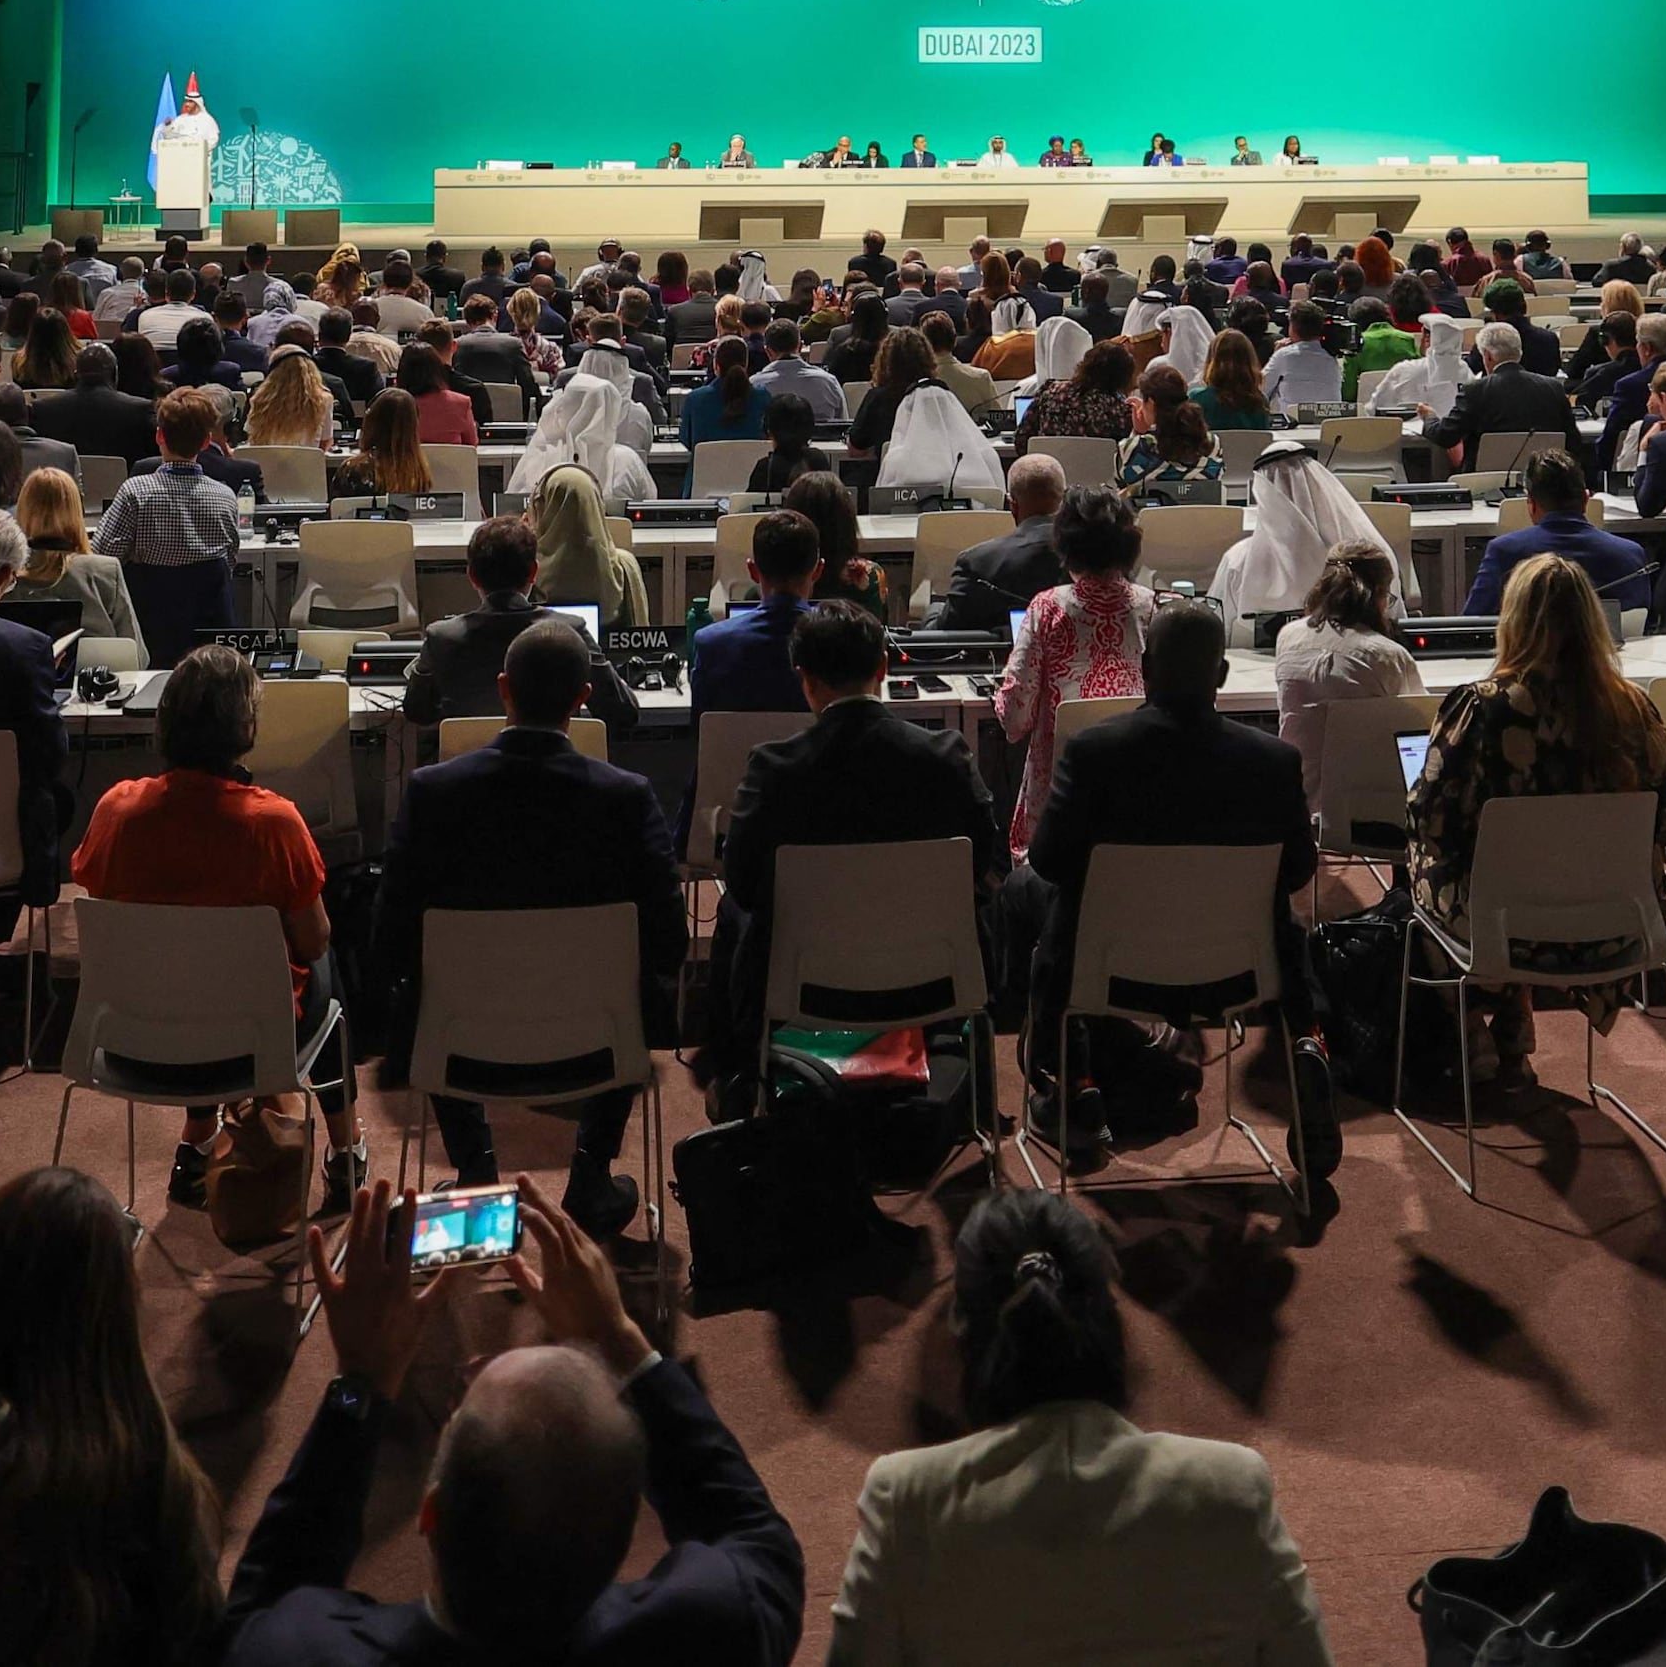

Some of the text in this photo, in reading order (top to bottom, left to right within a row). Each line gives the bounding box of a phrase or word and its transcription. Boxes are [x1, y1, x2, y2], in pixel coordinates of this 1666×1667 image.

[924, 34, 1036, 56] DUBAI 2023
[894, 489, 919, 501] IICA
[1177, 484, 1192, 495] IIF
[416, 497, 436, 510] IEC
[215, 634, 276, 651] ESCAP
[608, 631, 669, 649] ESCWA
